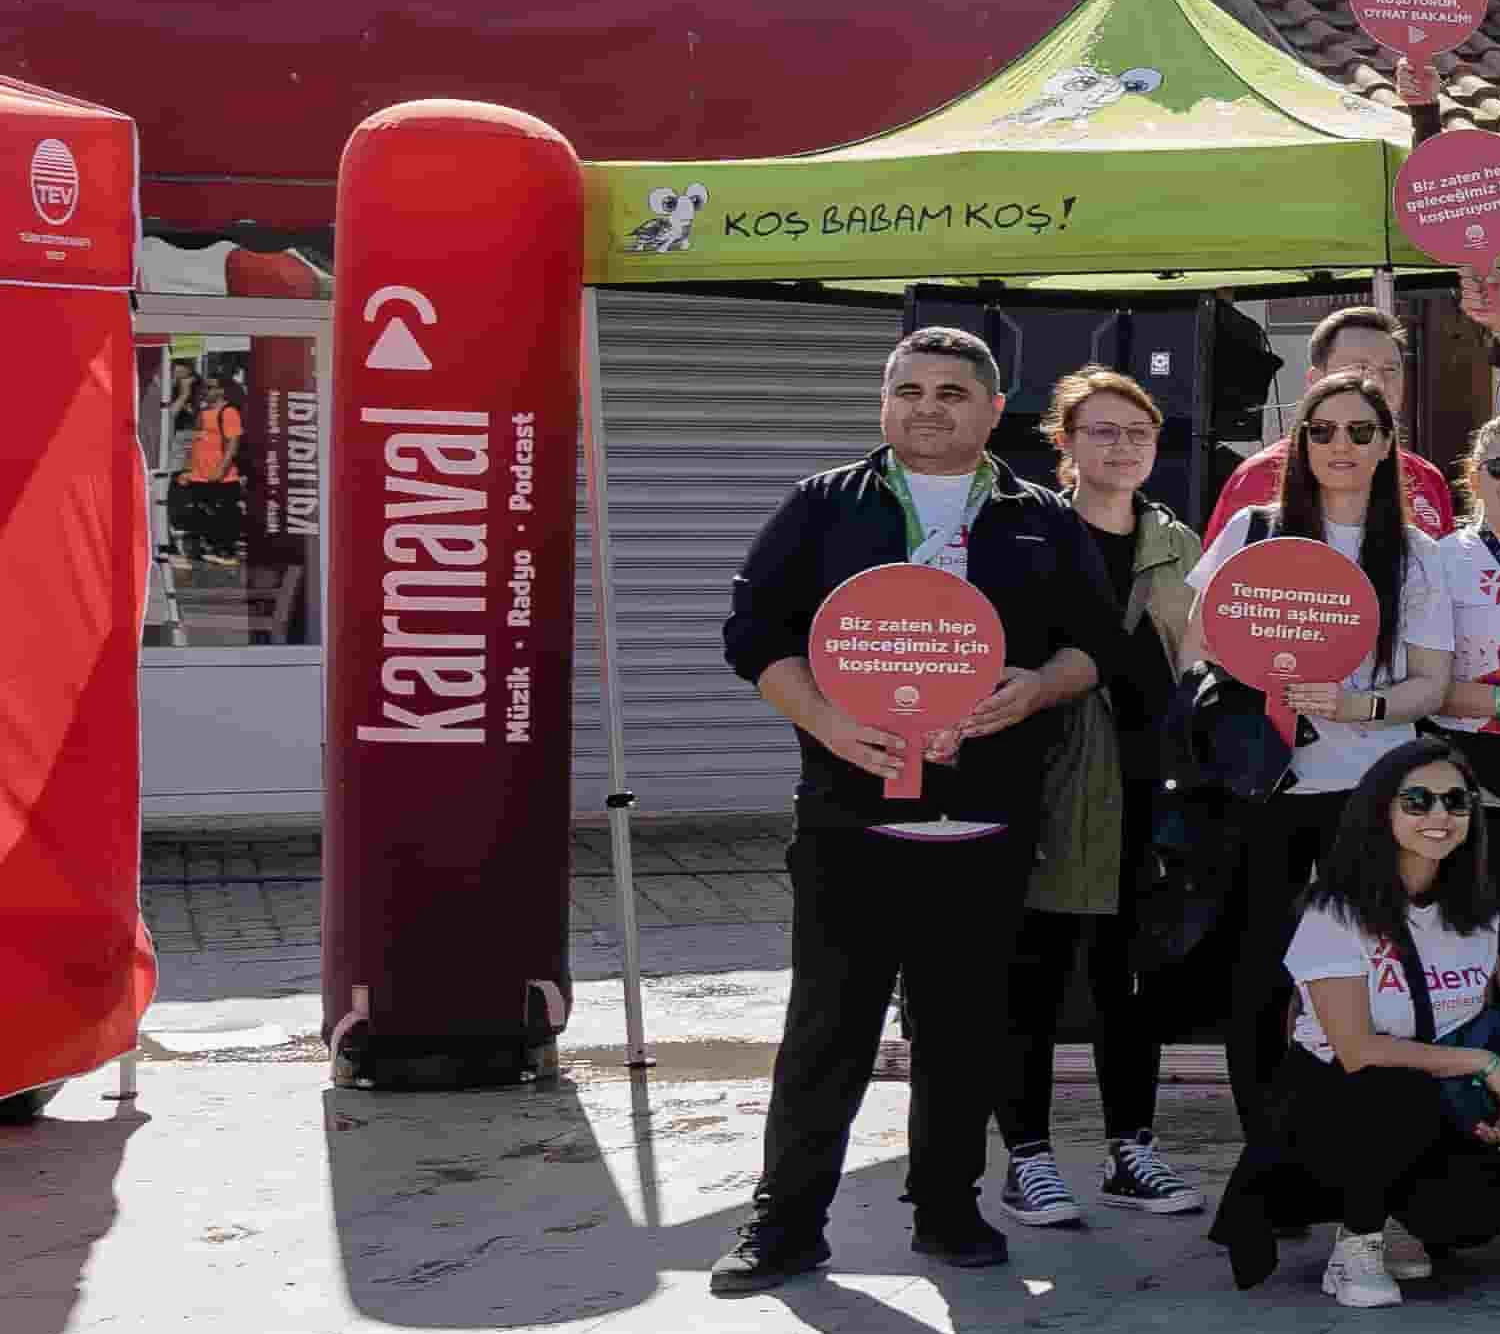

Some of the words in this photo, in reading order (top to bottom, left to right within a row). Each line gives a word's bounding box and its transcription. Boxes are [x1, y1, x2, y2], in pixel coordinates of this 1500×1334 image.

[36, 184, 73, 205] TEV
[724, 210, 809, 241] KOŞ
[821, 202, 953, 235] BABAM
[508, 410, 537, 512] Podcast
[356, 407, 490, 744] karnaval
[506, 549, 536, 628] Radyo
[1231, 582, 1351, 607] Tempomuzu
[839, 616, 873, 632] Biz
[877, 618, 933, 634] zaten
[938, 618, 977, 635] hep
[1216, 602, 1281, 620] eğitim
[1287, 607, 1361, 627] aşkımız
[1250, 622, 1328, 643] belirler.
[824, 637, 951, 655] geleceğimiz
[953, 638, 990, 655] için
[838, 656, 977, 676] koşturuyoruz.
[505, 665, 531, 744] Müzik
